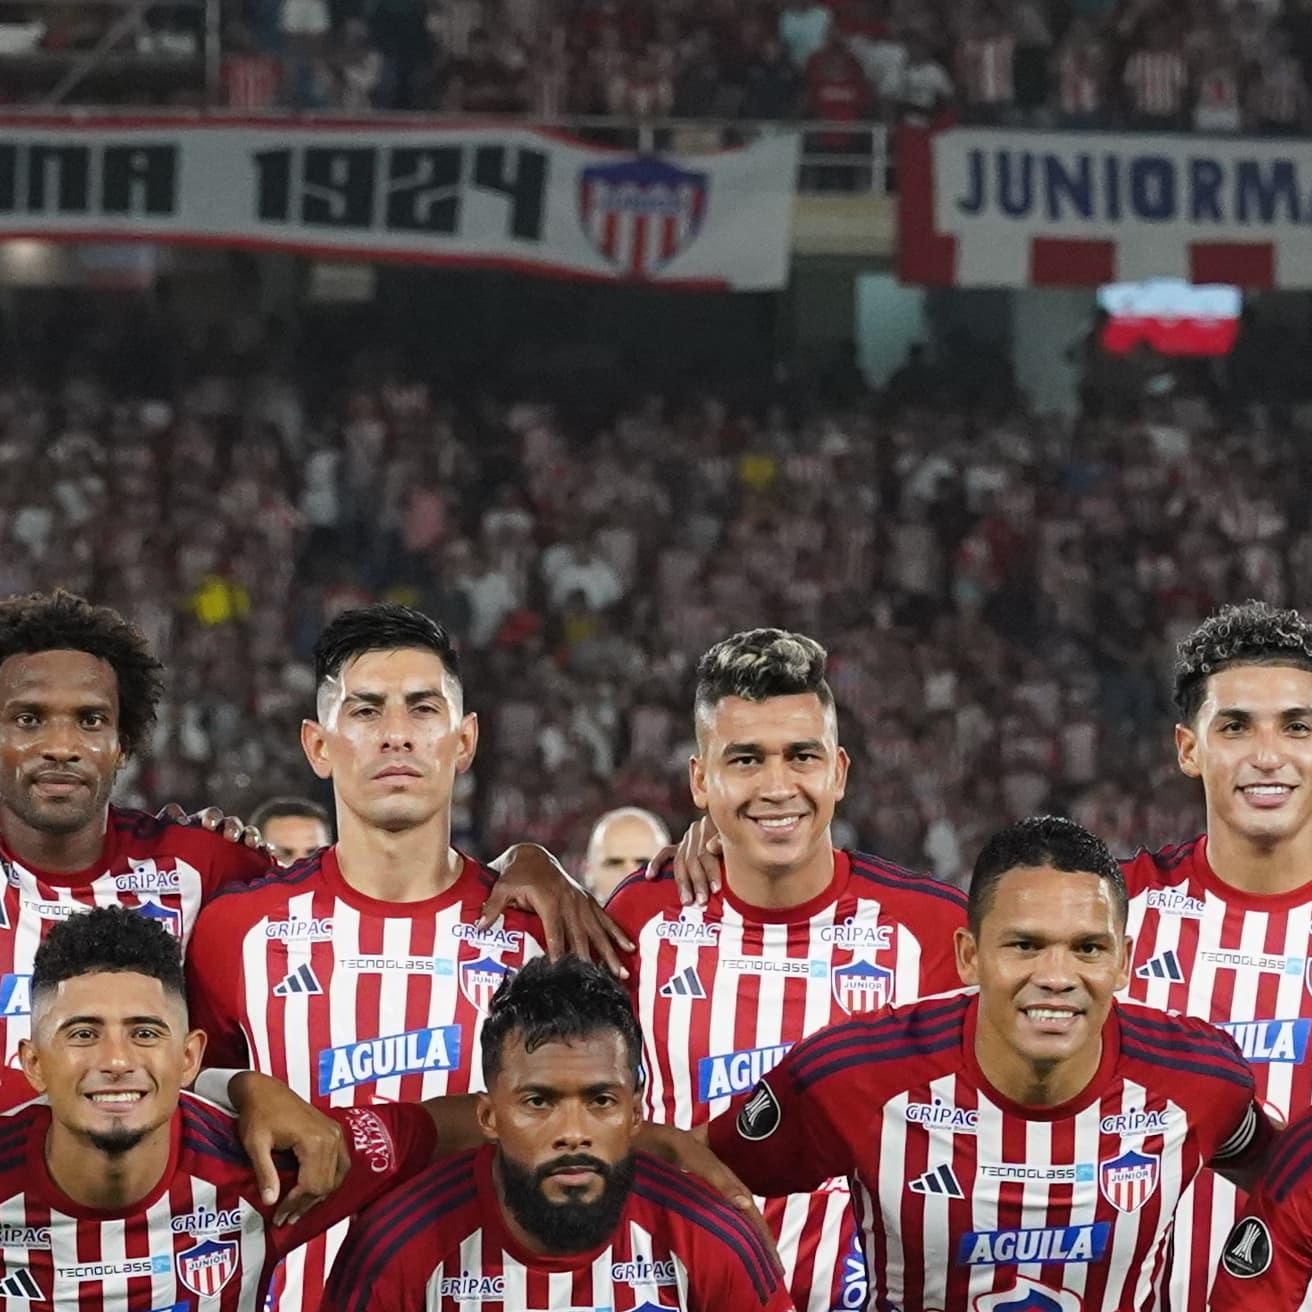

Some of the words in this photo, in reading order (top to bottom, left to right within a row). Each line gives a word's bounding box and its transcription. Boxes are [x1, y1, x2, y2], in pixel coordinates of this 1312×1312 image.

[254, 144, 550, 242] 1924
[330, 1029, 450, 1091] AGUILA
[966, 1225, 1095, 1265] AGUILA
